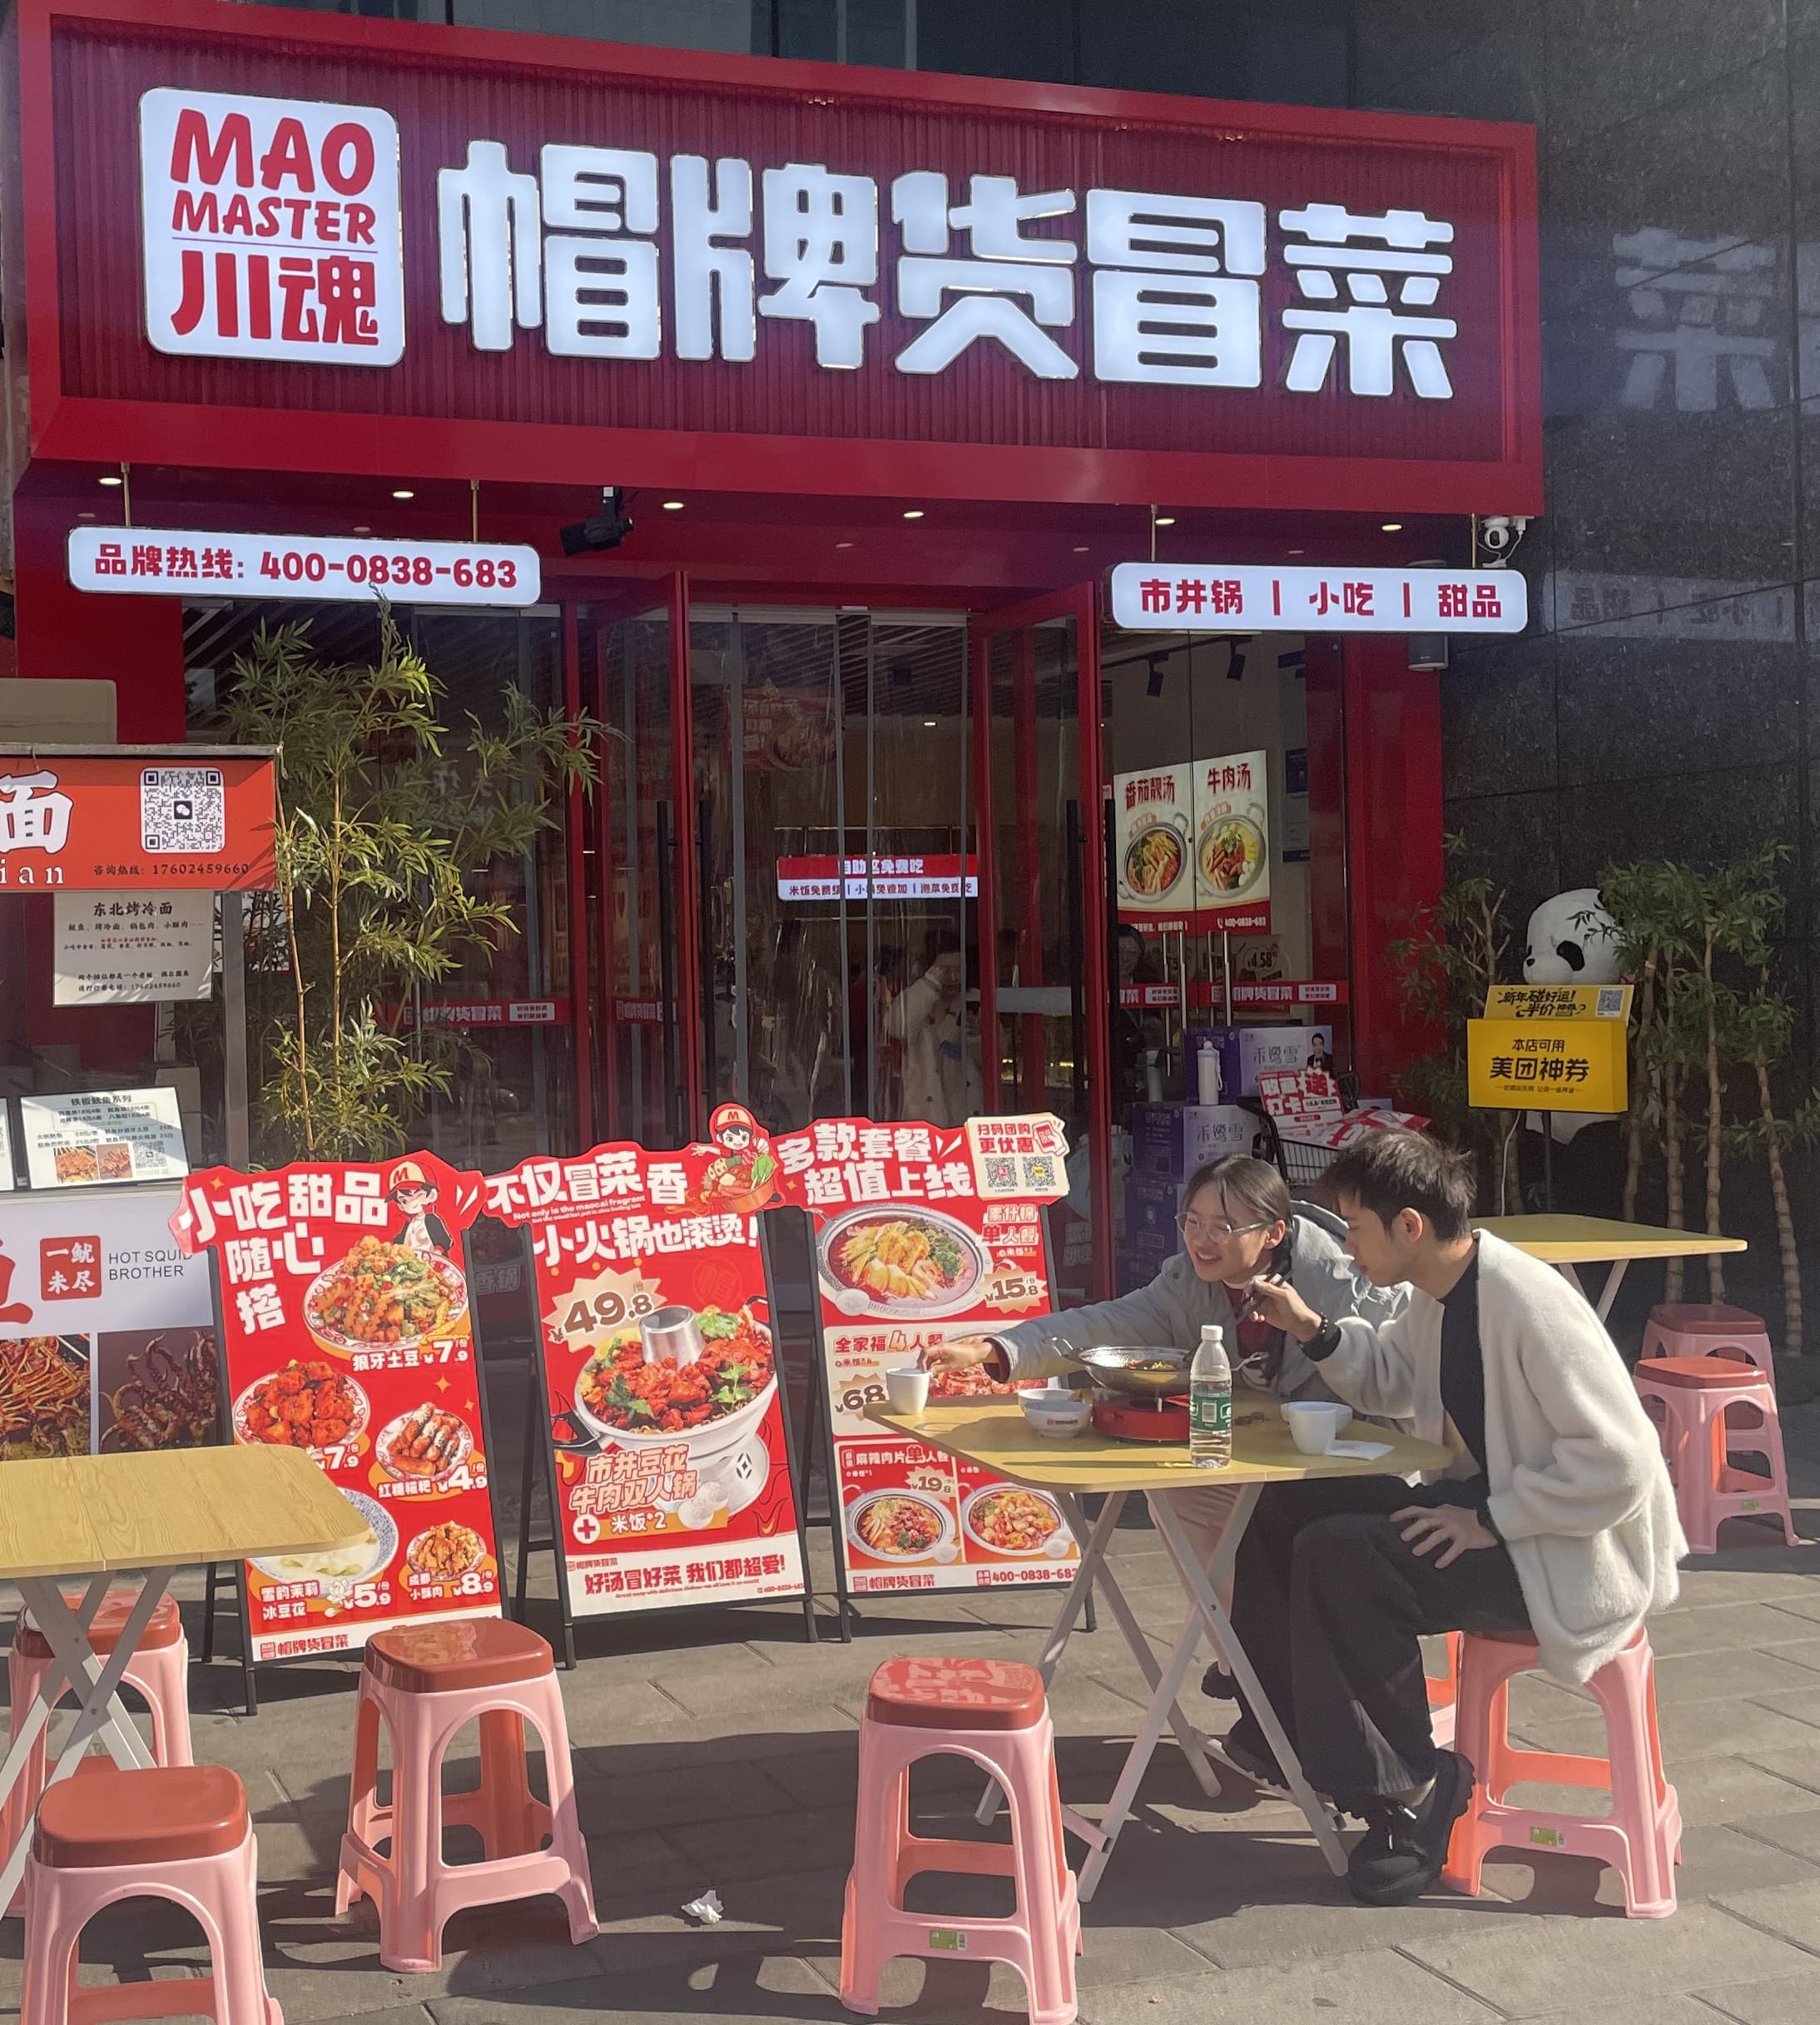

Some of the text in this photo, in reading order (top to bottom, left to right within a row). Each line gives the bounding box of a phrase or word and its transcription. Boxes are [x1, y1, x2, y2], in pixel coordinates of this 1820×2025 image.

[170, 108, 375, 196] MAO
[171, 197, 377, 246] MASTER
[437, 139, 1458, 400] 帽牌货冒菜
[171, 250, 379, 346] 川魂
[260, 550, 518, 588] 400-0838-683
[1139, 578, 1502, 618] 市井锅 小吃 甜品
[1208, 763, 1252, 794] 牛肉汤
[1126, 775, 1175, 811] 番茄靓汤
[0, 769, 73, 854] 面
[152, 863, 250, 875] 17602459660
[93, 901, 173, 916] 东北烤冷面
[1512, 1039, 1565, 1053] 本店可用
[1490, 1056, 1590, 1083] 美团神券
[71, 1094, 133, 1106] 铁板鱿鱼系列
[727, 1111, 740, 1121] M
[978, 1124, 1030, 1135] 扫码团购
[776, 1121, 933, 1175] 多款套餐
[979, 1137, 1034, 1154] 更优惠
[394, 1166, 409, 1183] M
[484, 1150, 688, 1214] 不仅冒菜香
[804, 1161, 974, 1205] 超值上线
[177, 1171, 388, 1244] 小吃甜品
[533, 1214, 759, 1267] 小火锅也滚烫!
[982, 1225, 1036, 1244] 单人餐
[46, 1242, 96, 1263] 一鱿
[109, 1252, 141, 1264] HOT
[225, 1222, 325, 1284] 随心
[47, 1269, 96, 1294] 未尽
[109, 1265, 184, 1280] BROTHER
[985, 1278, 1039, 1301] ¥15.8
[236, 1284, 286, 1335] 搭
[548, 1292, 653, 1345] ¥49.8
[353, 1351, 420, 1372] 狼牙土豆
[424, 1340, 469, 1365] ¥7.9
[588, 1443, 689, 1484] 市井豆花
[437, 1466, 488, 1492] ¥4.9
[571, 1471, 699, 1514] 牛肉双人锅
[453, 1572, 493, 1596] ¥8.9
[585, 1564, 683, 1596] 好汤冒好菜
[687, 1554, 785, 1584] 我们都超爱!
[869, 1574, 936, 1590] 帽牌货冒菜
[342, 1582, 392, 1609] ¥5.9
[263, 1601, 307, 1620] 冰豆花
[278, 1634, 349, 1655] 帽牌货冒菜
